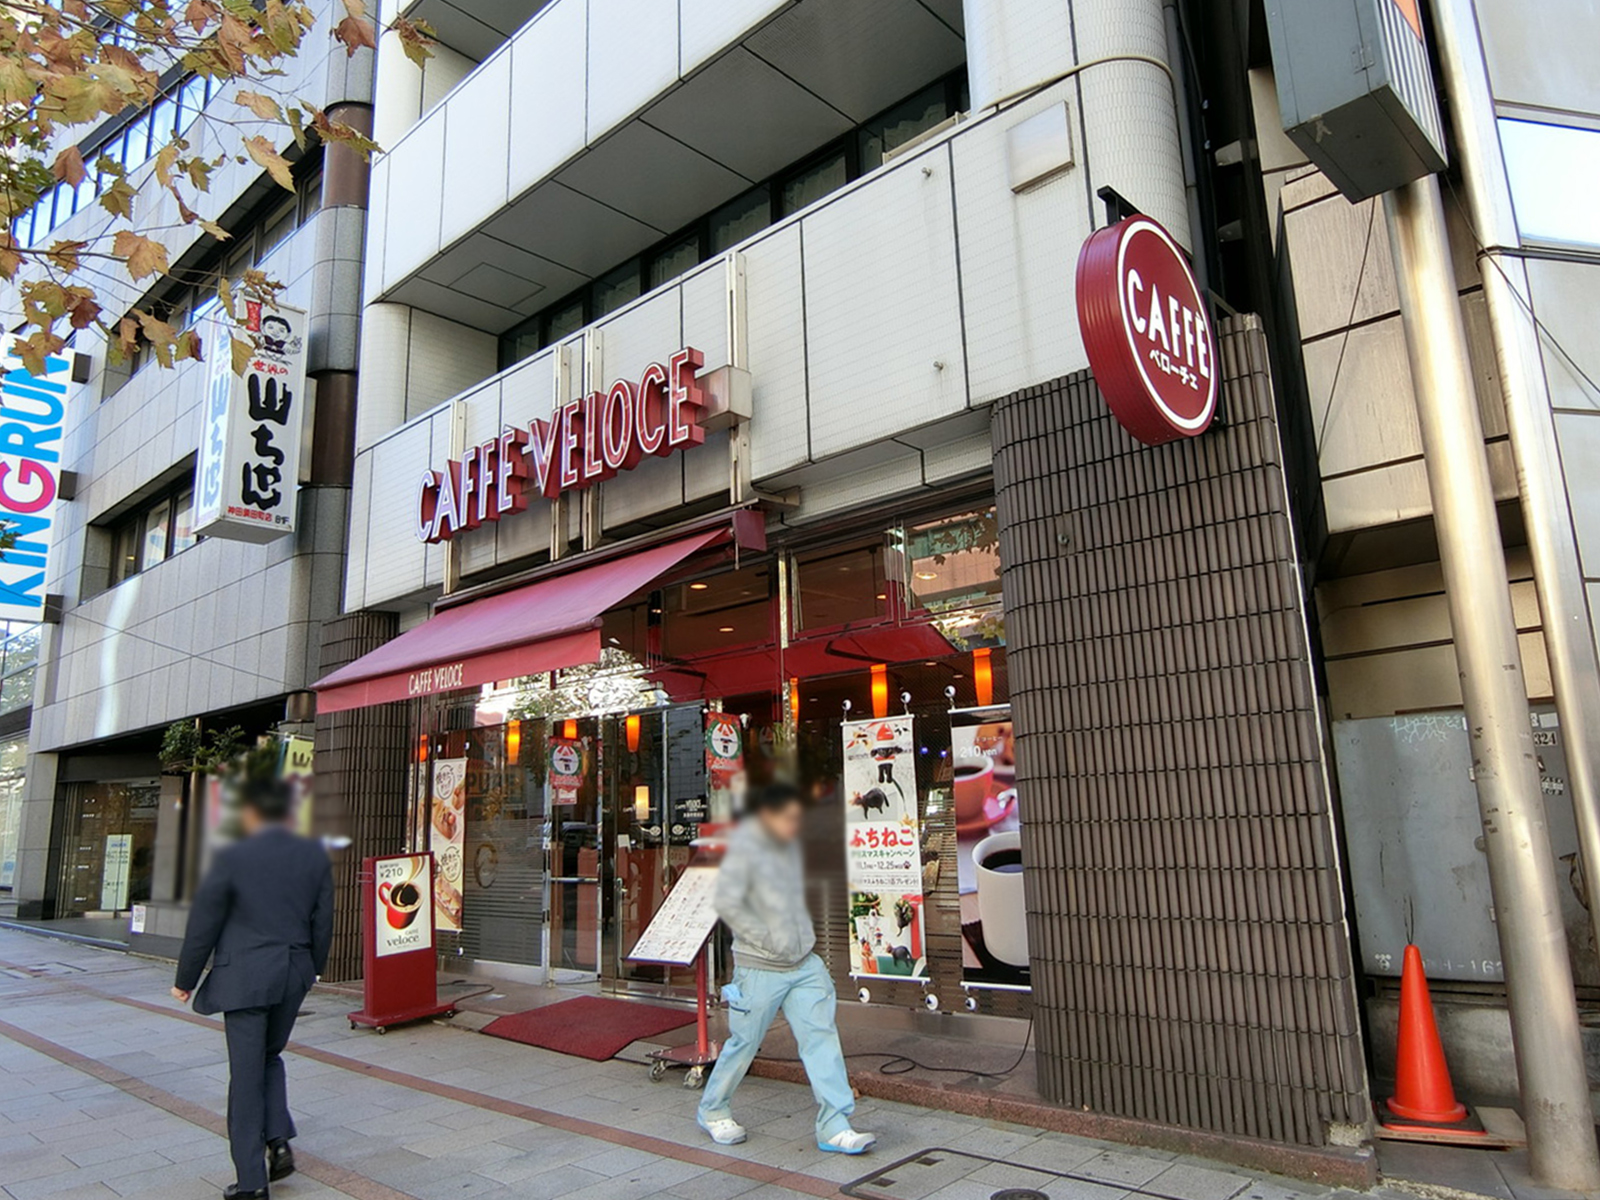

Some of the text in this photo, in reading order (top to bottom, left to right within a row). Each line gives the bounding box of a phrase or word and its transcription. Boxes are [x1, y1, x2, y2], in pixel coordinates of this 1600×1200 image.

[1149, 349, 1199, 390] ベローチェ
[528, 346, 705, 499] VELOCE
[241, 373, 293, 511] 山ちゃん
[433, 663, 463, 690] VELOCE
[960, 745, 998, 758] 210 yen
[850, 827, 914, 849] ふちねこ
[387, 935, 419, 947] veloce
